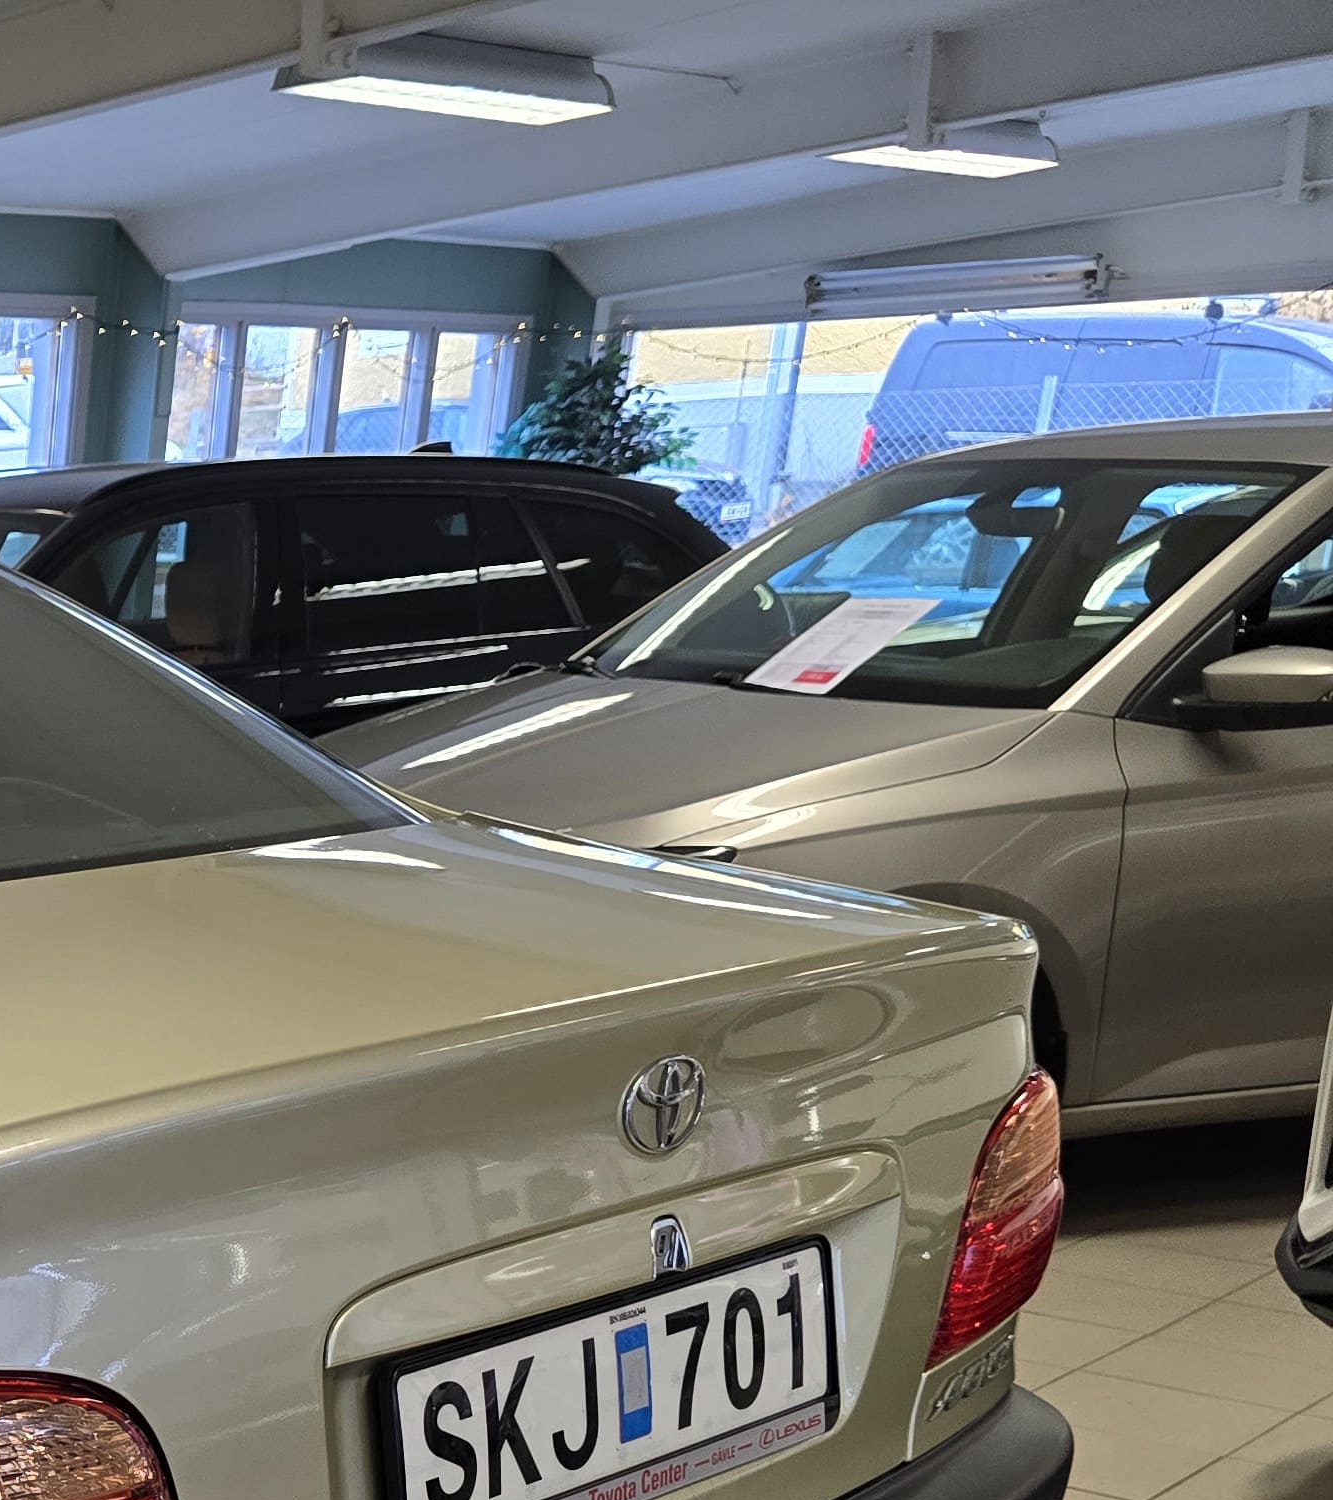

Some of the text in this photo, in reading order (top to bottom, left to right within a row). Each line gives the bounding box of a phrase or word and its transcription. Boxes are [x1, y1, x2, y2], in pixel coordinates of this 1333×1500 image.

[664, 1271, 805, 1431] 701
[641, 1461, 689, 1495] Center
[711, 1445, 737, 1466] GÄVLE
[776, 1413, 822, 1440] LEXUS
